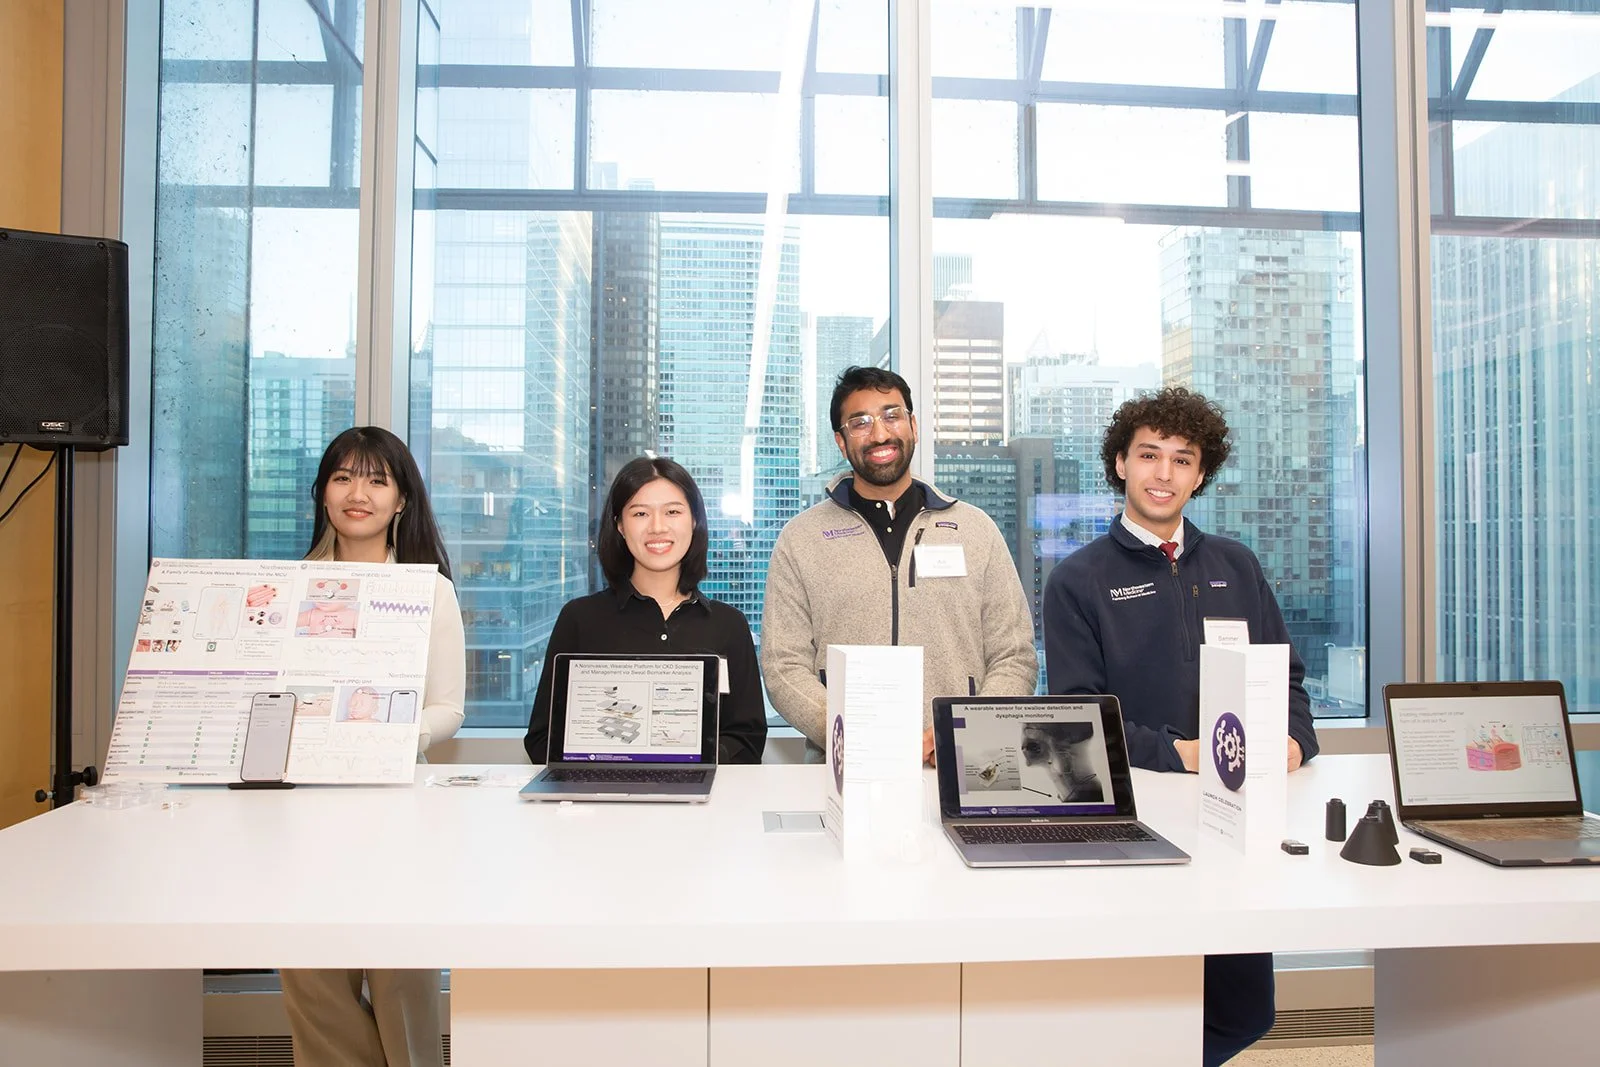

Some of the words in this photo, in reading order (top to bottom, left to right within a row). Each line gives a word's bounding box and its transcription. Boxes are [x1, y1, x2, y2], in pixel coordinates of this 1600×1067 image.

[1123, 582, 1154, 592] Northwestern
[1203, 791, 1218, 800] LAUNCH
[1218, 797, 1242, 811] CELEBRATION
